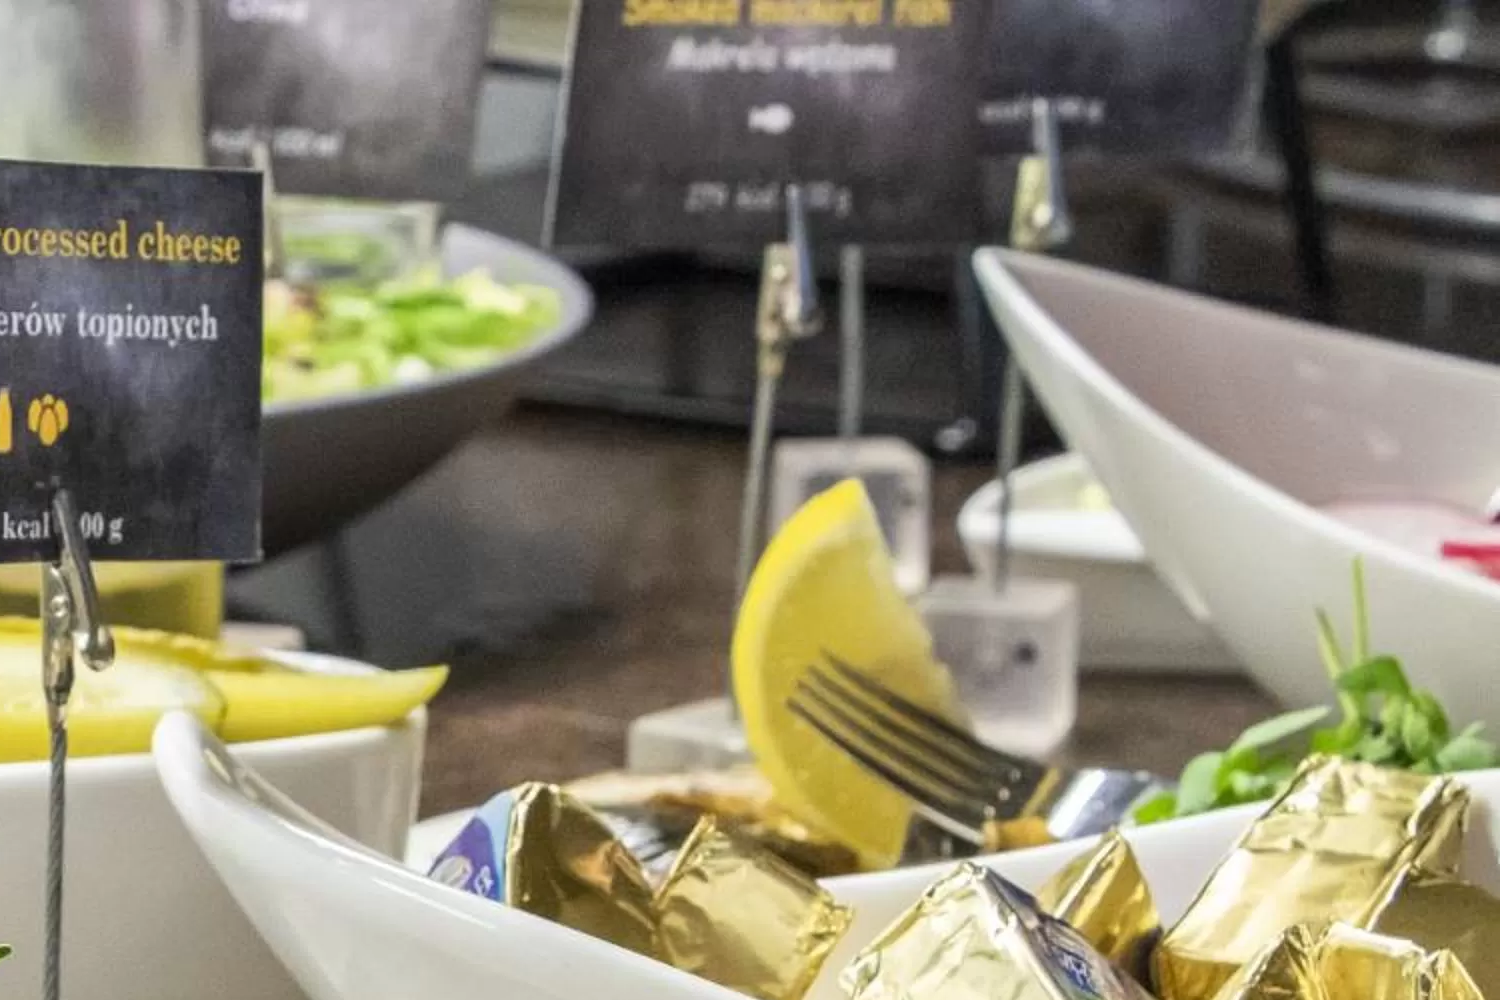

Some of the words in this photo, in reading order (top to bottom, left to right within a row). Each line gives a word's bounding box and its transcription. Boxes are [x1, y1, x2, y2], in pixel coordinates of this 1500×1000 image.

[137, 220, 242, 263] cheese
[77, 304, 219, 346] topionych
[2, 511, 50, 540] kcal
[73, 511, 105, 539] 00
[107, 516, 125, 545] g
